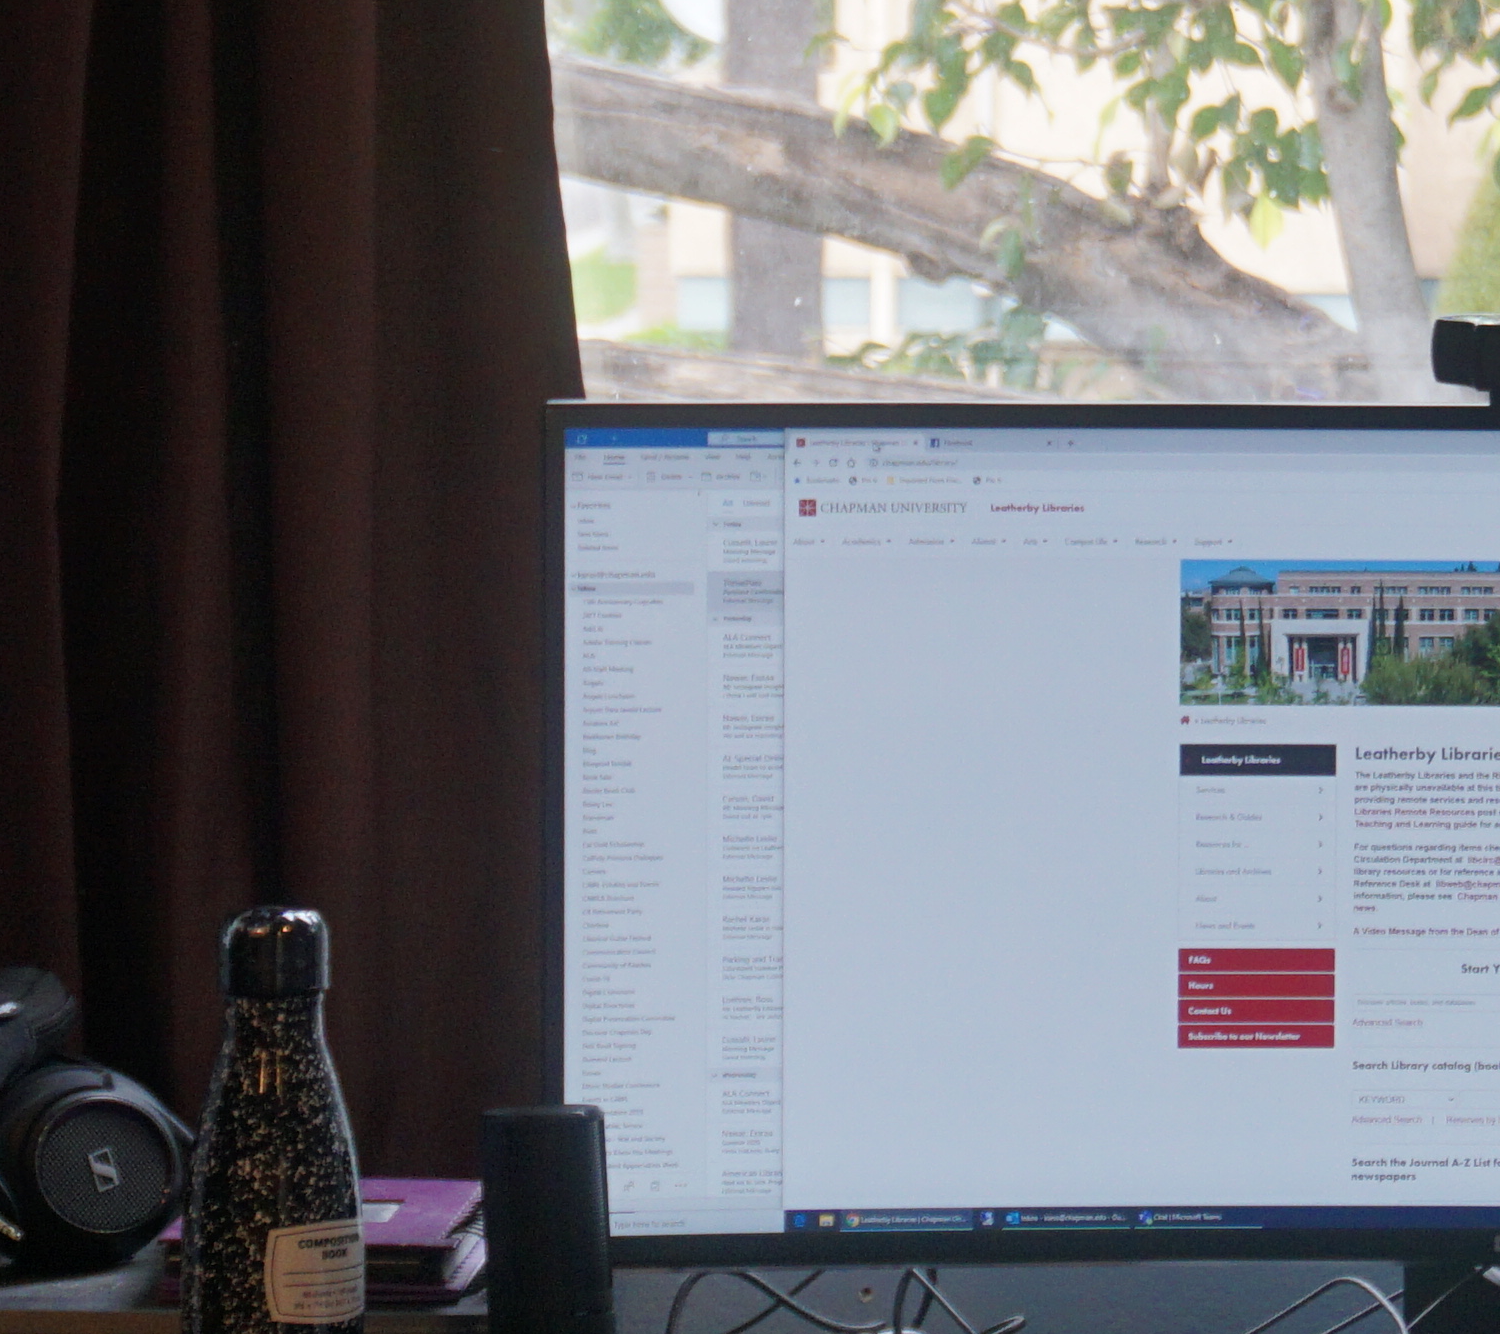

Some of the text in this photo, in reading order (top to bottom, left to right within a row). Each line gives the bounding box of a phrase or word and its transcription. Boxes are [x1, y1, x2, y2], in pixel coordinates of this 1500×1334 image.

[820, 501, 966, 513] CHAPMAN UNIVERSITY
[990, 503, 1084, 513] Leatherby Libraries
[1355, 747, 1435, 763] Leatherby
[1201, 755, 1281, 765] Leatherby Libraries
[1355, 771, 1371, 779] The
[1372, 771, 1415, 780] Leatherby
[1417, 771, 1456, 779] Libraries
[1475, 771, 1490, 780] the
[1353, 808, 1392, 816] Libraries
[1394, 808, 1427, 816] Remote
[1477, 809, 1497, 817] post
[1361, 927, 1386, 935] Video
[1388, 928, 1426, 938] Message
[1466, 927, 1488, 936] Dean
[1188, 955, 1211, 964] FAQs
[1461, 964, 1489, 974] Start
[1187, 981, 1214, 990] Hours
[1187, 1006, 1220, 1015] Contact
[1352, 1061, 1388, 1070] Search
[1390, 1061, 1429, 1071] Library
[1431, 1062, 1471, 1071] catalog
[1351, 1158, 1388, 1167] Search
[1389, 1158, 1406, 1167] the
[1409, 1159, 1449, 1167] Journal
[1451, 1158, 1471, 1167] A-Z
[1473, 1158, 1491, 1167] List
[1350, 1173, 1416, 1182] newspapers
